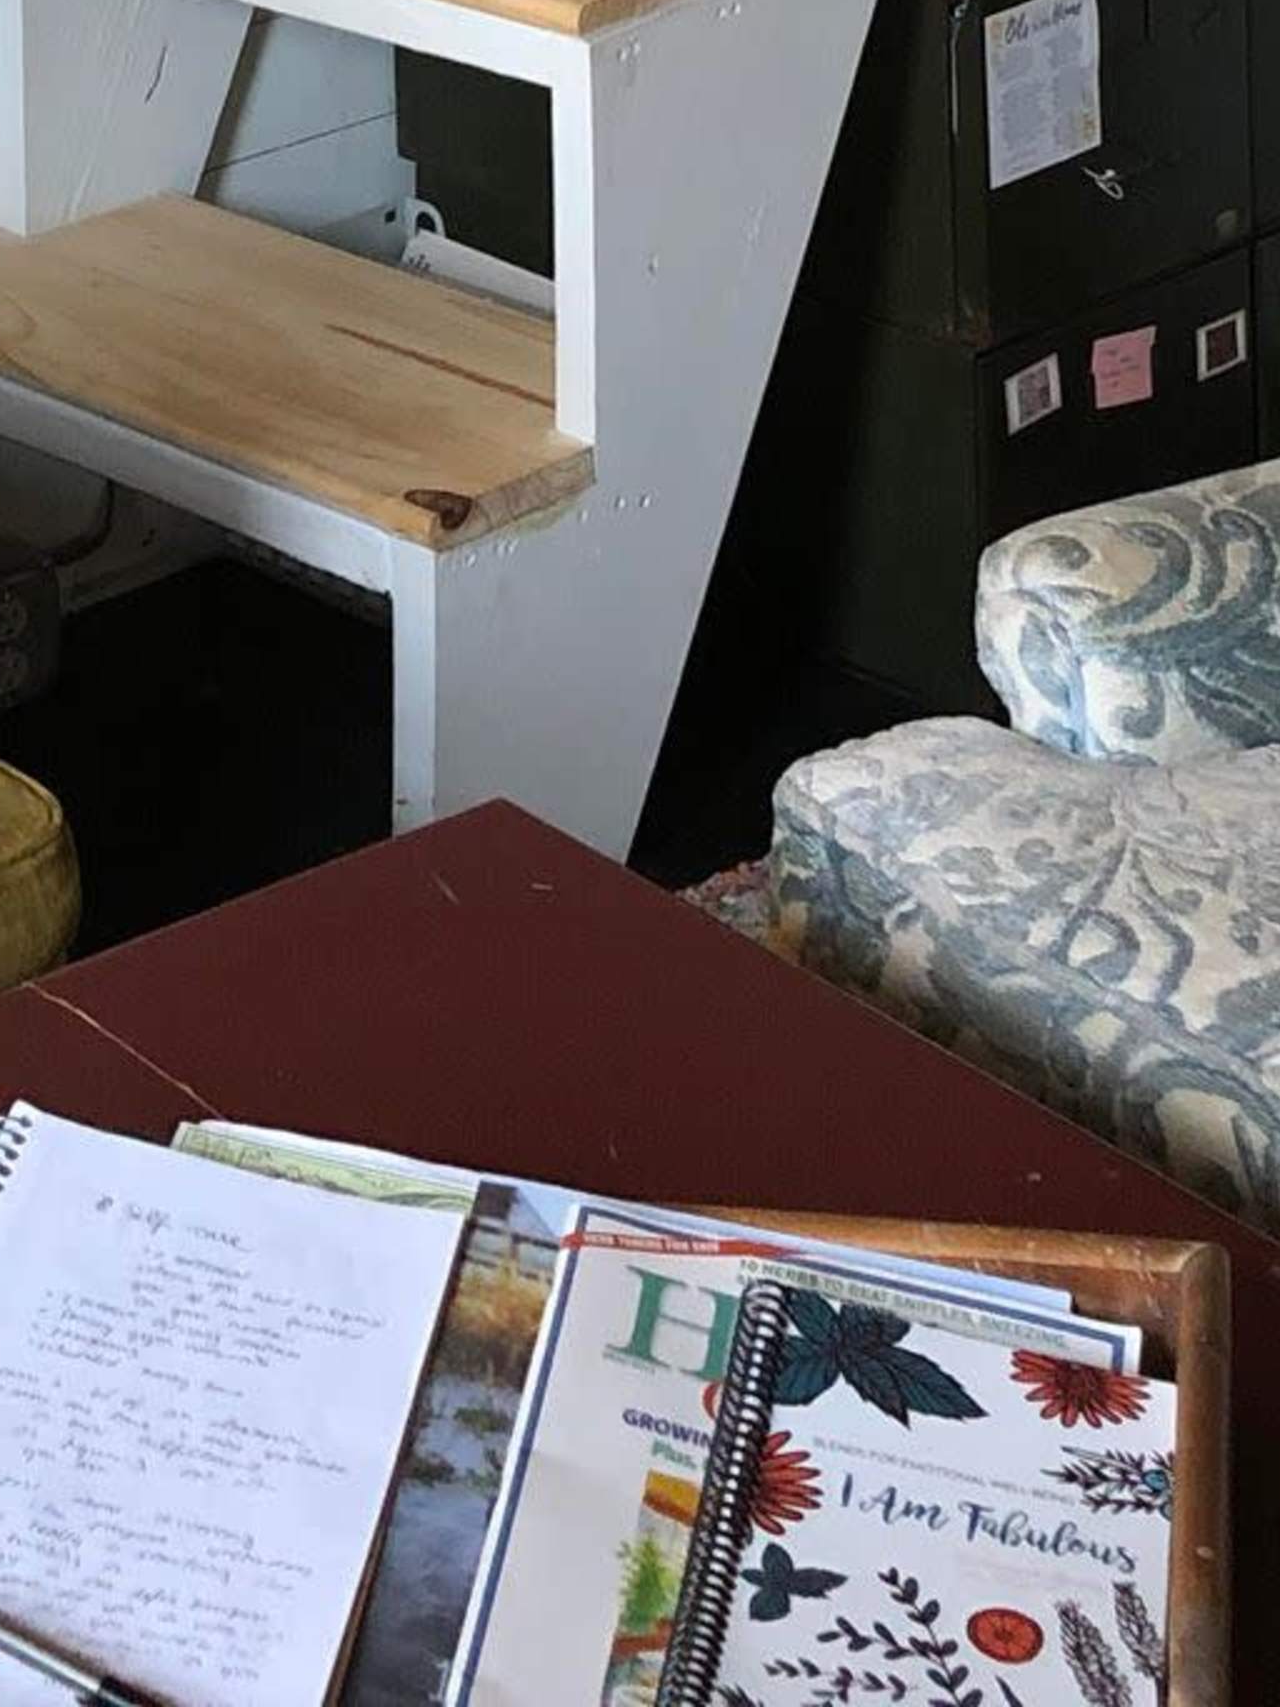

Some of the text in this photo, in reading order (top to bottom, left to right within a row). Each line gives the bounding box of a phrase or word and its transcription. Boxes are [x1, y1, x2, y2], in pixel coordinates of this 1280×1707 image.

[840, 1472, 854, 1508] I
[858, 1485, 951, 1530] Am
[957, 1500, 1136, 1574] Fabulous
